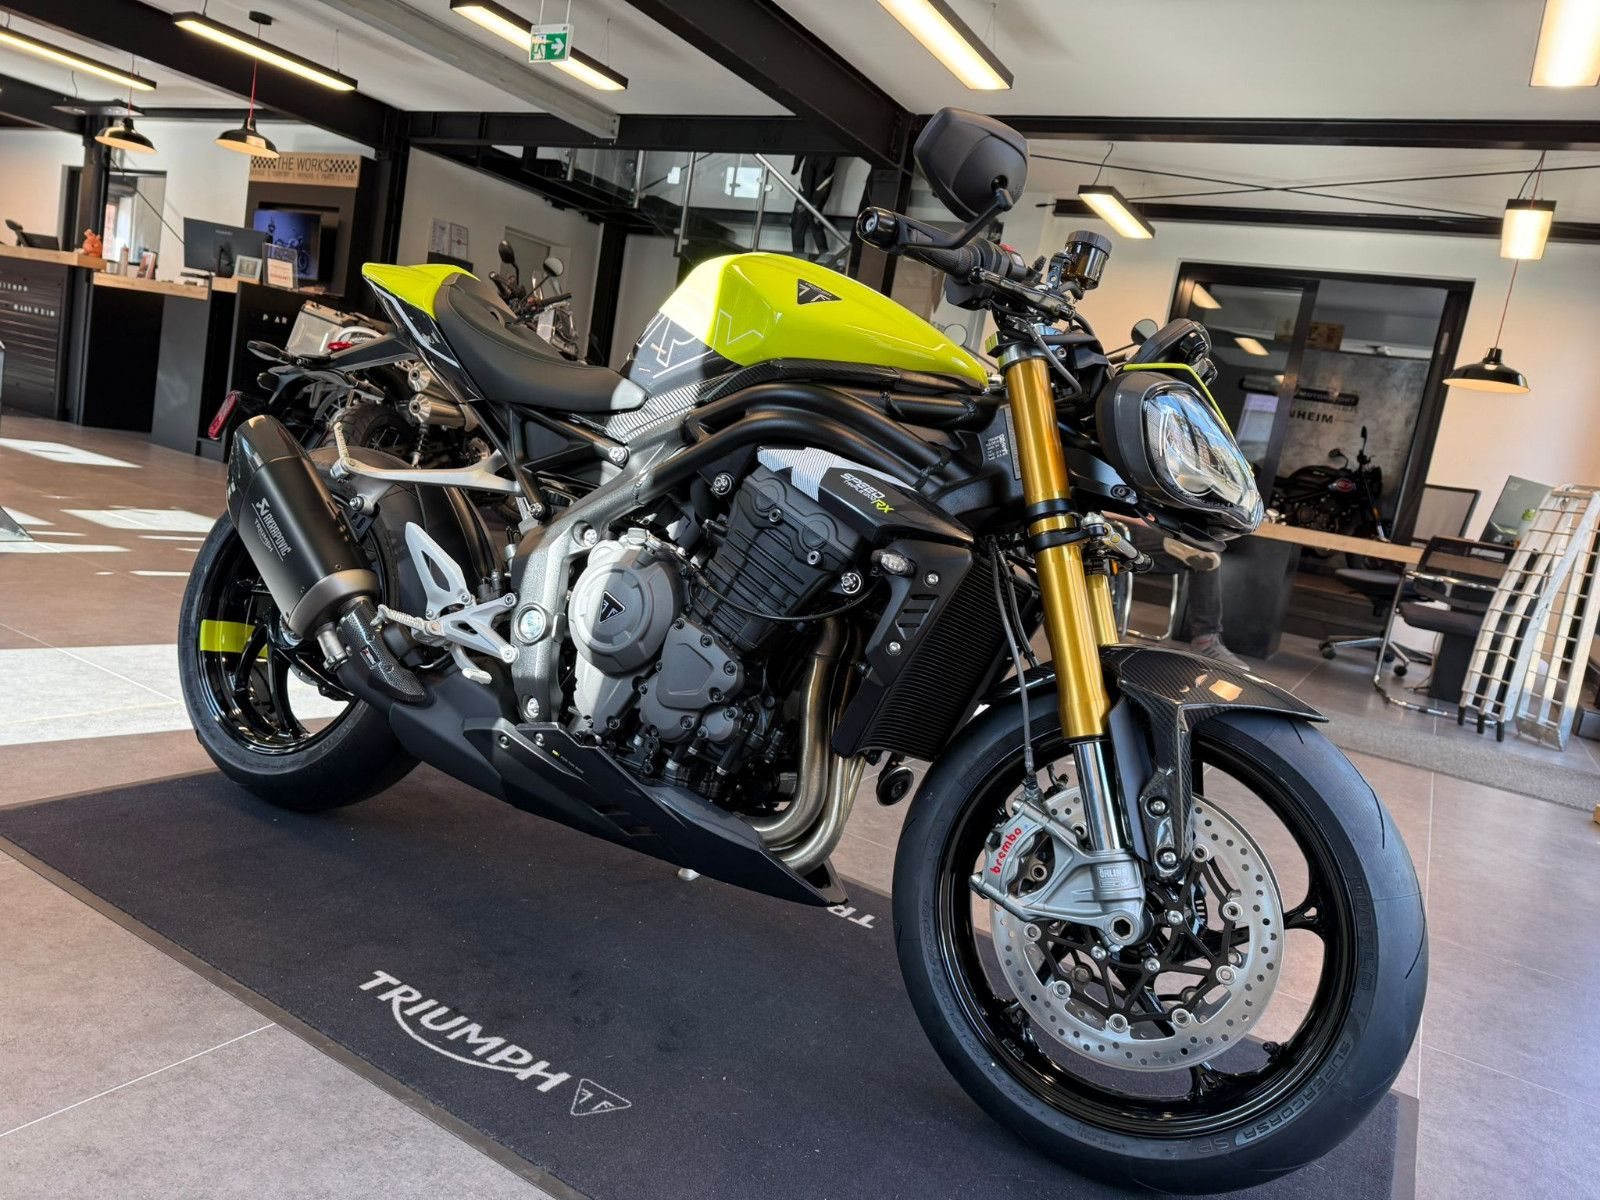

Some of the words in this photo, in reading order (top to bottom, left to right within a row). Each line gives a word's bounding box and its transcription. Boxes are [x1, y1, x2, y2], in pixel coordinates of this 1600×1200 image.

[276, 157, 294, 170] THE
[296, 158, 330, 172] WORKS
[262, 313, 288, 325] PAR
[1289, 409, 1334, 424] NHEIM
[840, 473, 886, 499] SPEED
[871, 499, 895, 513] RX
[990, 828, 1022, 874] brembo
[358, 970, 572, 1093] TRIUMPH
[1242, 1040, 1352, 1140] SUPERCORSA
